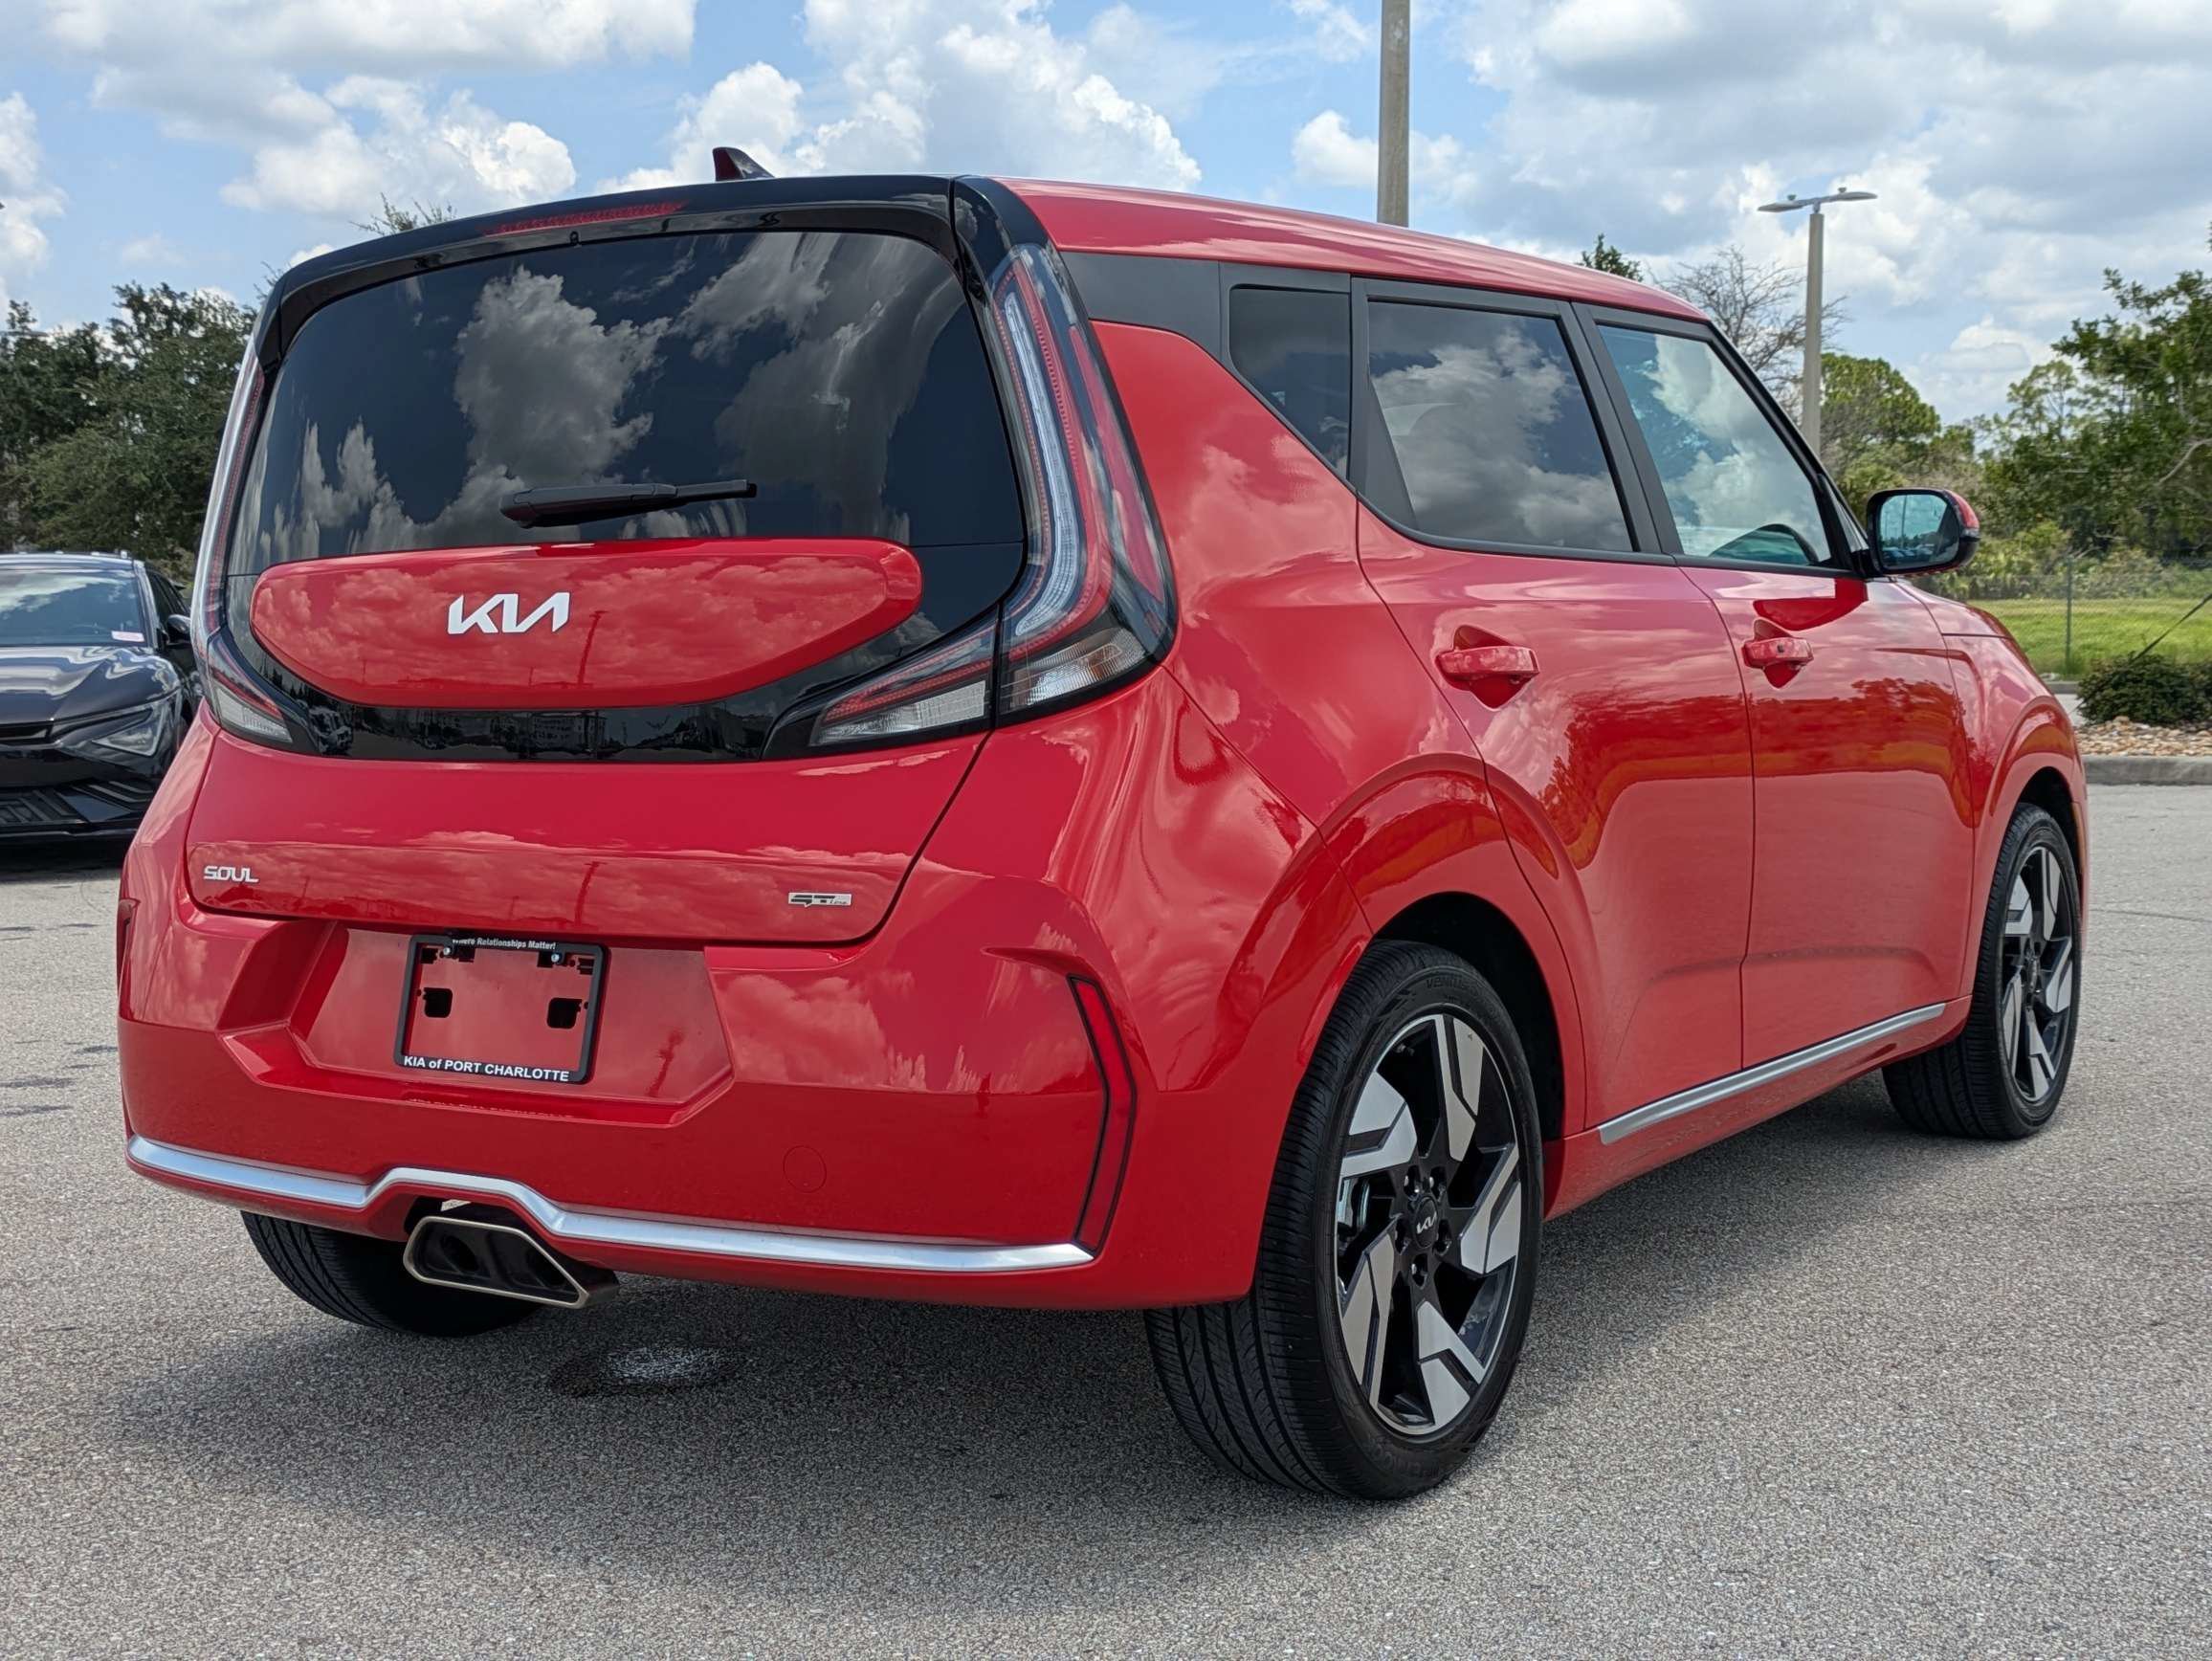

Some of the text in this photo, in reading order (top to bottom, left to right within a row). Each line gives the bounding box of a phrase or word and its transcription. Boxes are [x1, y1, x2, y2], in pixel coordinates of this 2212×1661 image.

[447, 591, 570, 634] KIA
[203, 865, 260, 883] SOUL
[476, 937, 527, 949] Relationships
[528, 941, 557, 950] Matter!
[403, 1054, 570, 1082] KIA of PORT CHARLOTTE
